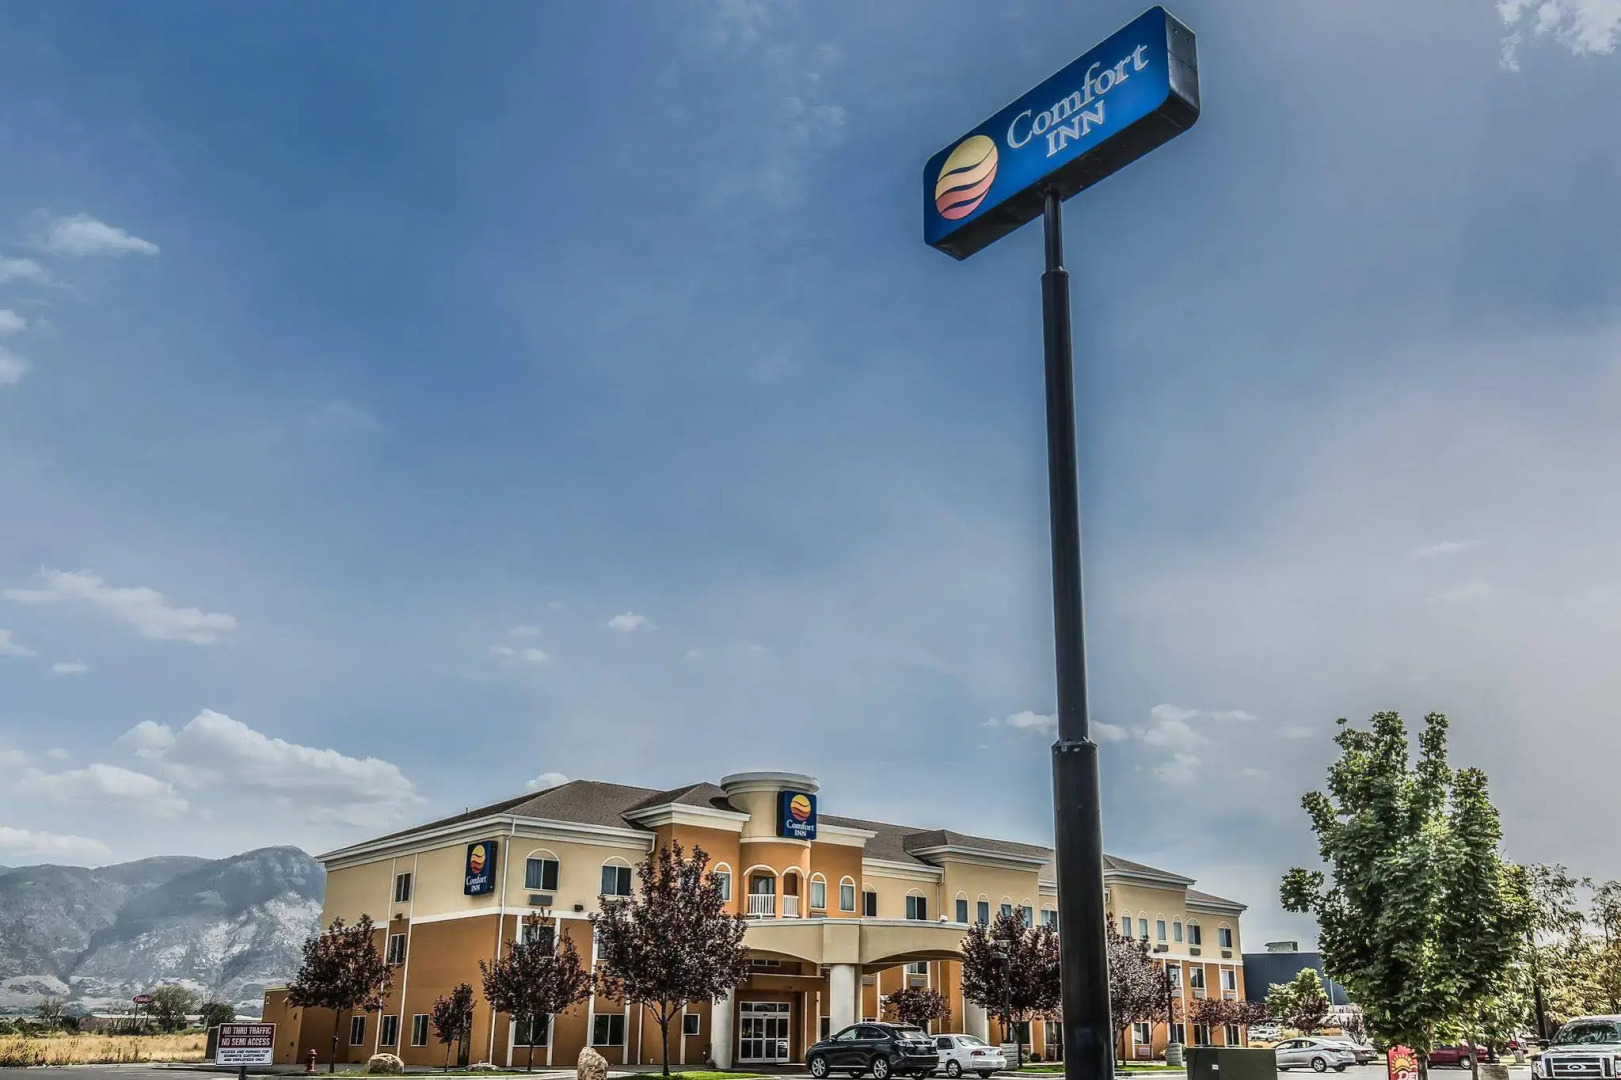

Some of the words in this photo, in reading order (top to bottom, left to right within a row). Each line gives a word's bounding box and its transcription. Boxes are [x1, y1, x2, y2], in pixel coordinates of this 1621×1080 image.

[1007, 43, 1149, 149] Comfort
[1046, 99, 1106, 158] INN
[786, 819, 815, 831] Comfort
[466, 874, 487, 885] Comfort
[222, 1026, 232, 1035] NO
[233, 1026, 248, 1035] THRU
[249, 1026, 272, 1035] TRAFFIC
[221, 1038, 230, 1046] NO
[231, 1038, 247, 1046] SEMI
[247, 1038, 270, 1046] ACCESS
